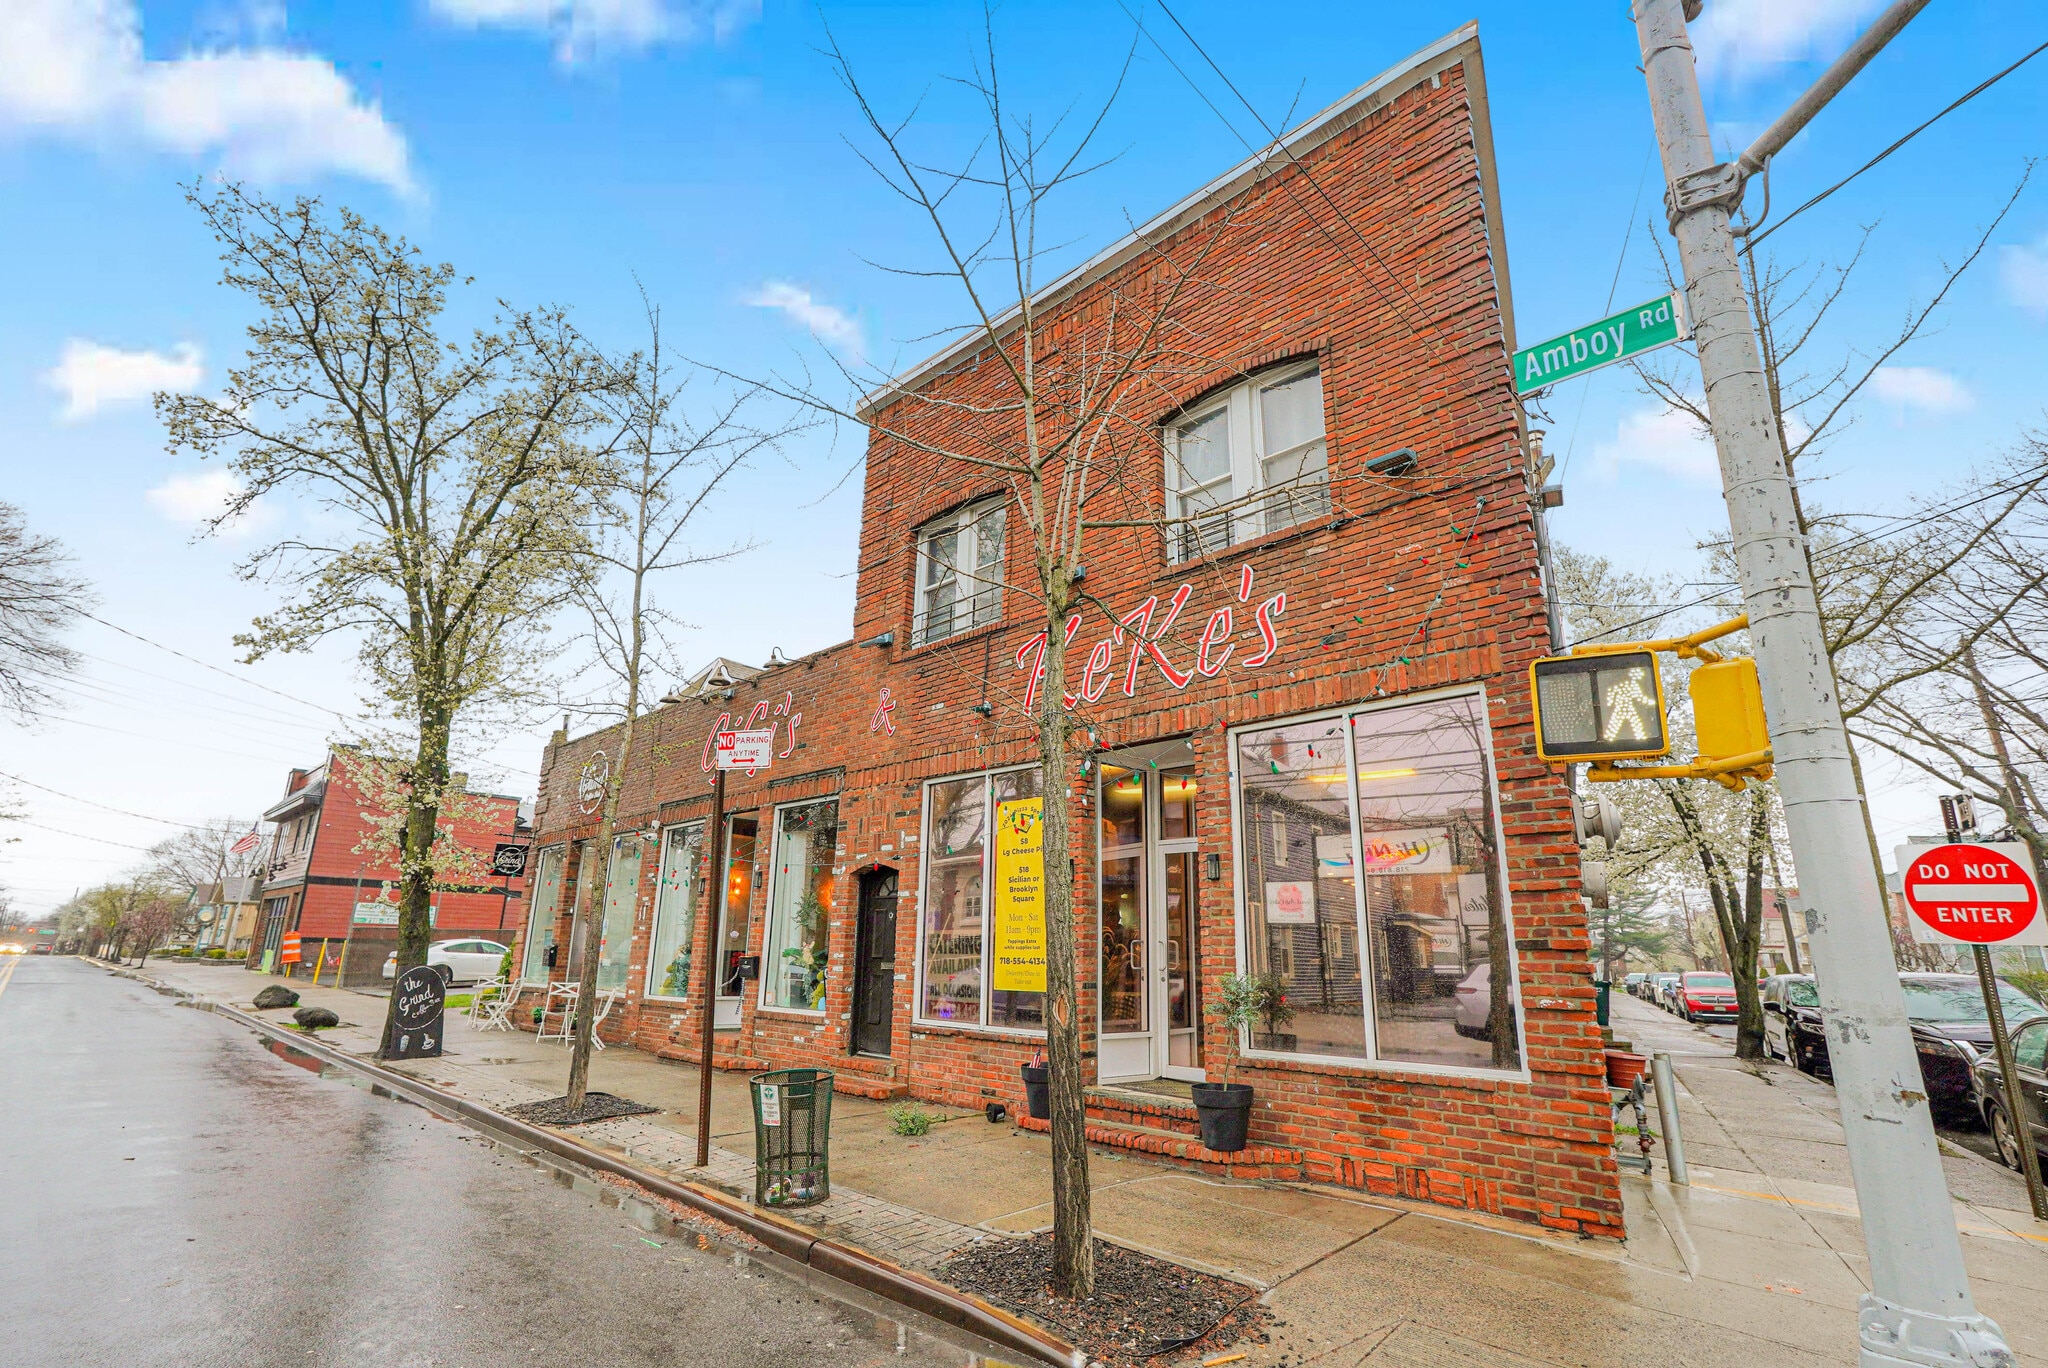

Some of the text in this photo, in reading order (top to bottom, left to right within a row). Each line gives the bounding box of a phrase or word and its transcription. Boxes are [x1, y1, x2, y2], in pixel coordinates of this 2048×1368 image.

[1525, 302, 1670, 381] Amboy Rd
[720, 735, 769, 748] NO PARKING
[1003, 849, 1010, 857] Lg
[1918, 863, 2009, 879] DO NOT
[1012, 895, 1035, 903] Square
[1028, 913, 1039, 921] Sat
[1936, 907, 2014, 923] ENTER
[1026, 925, 1041, 935] 9pm
[929, 934, 981, 954] CATERING
